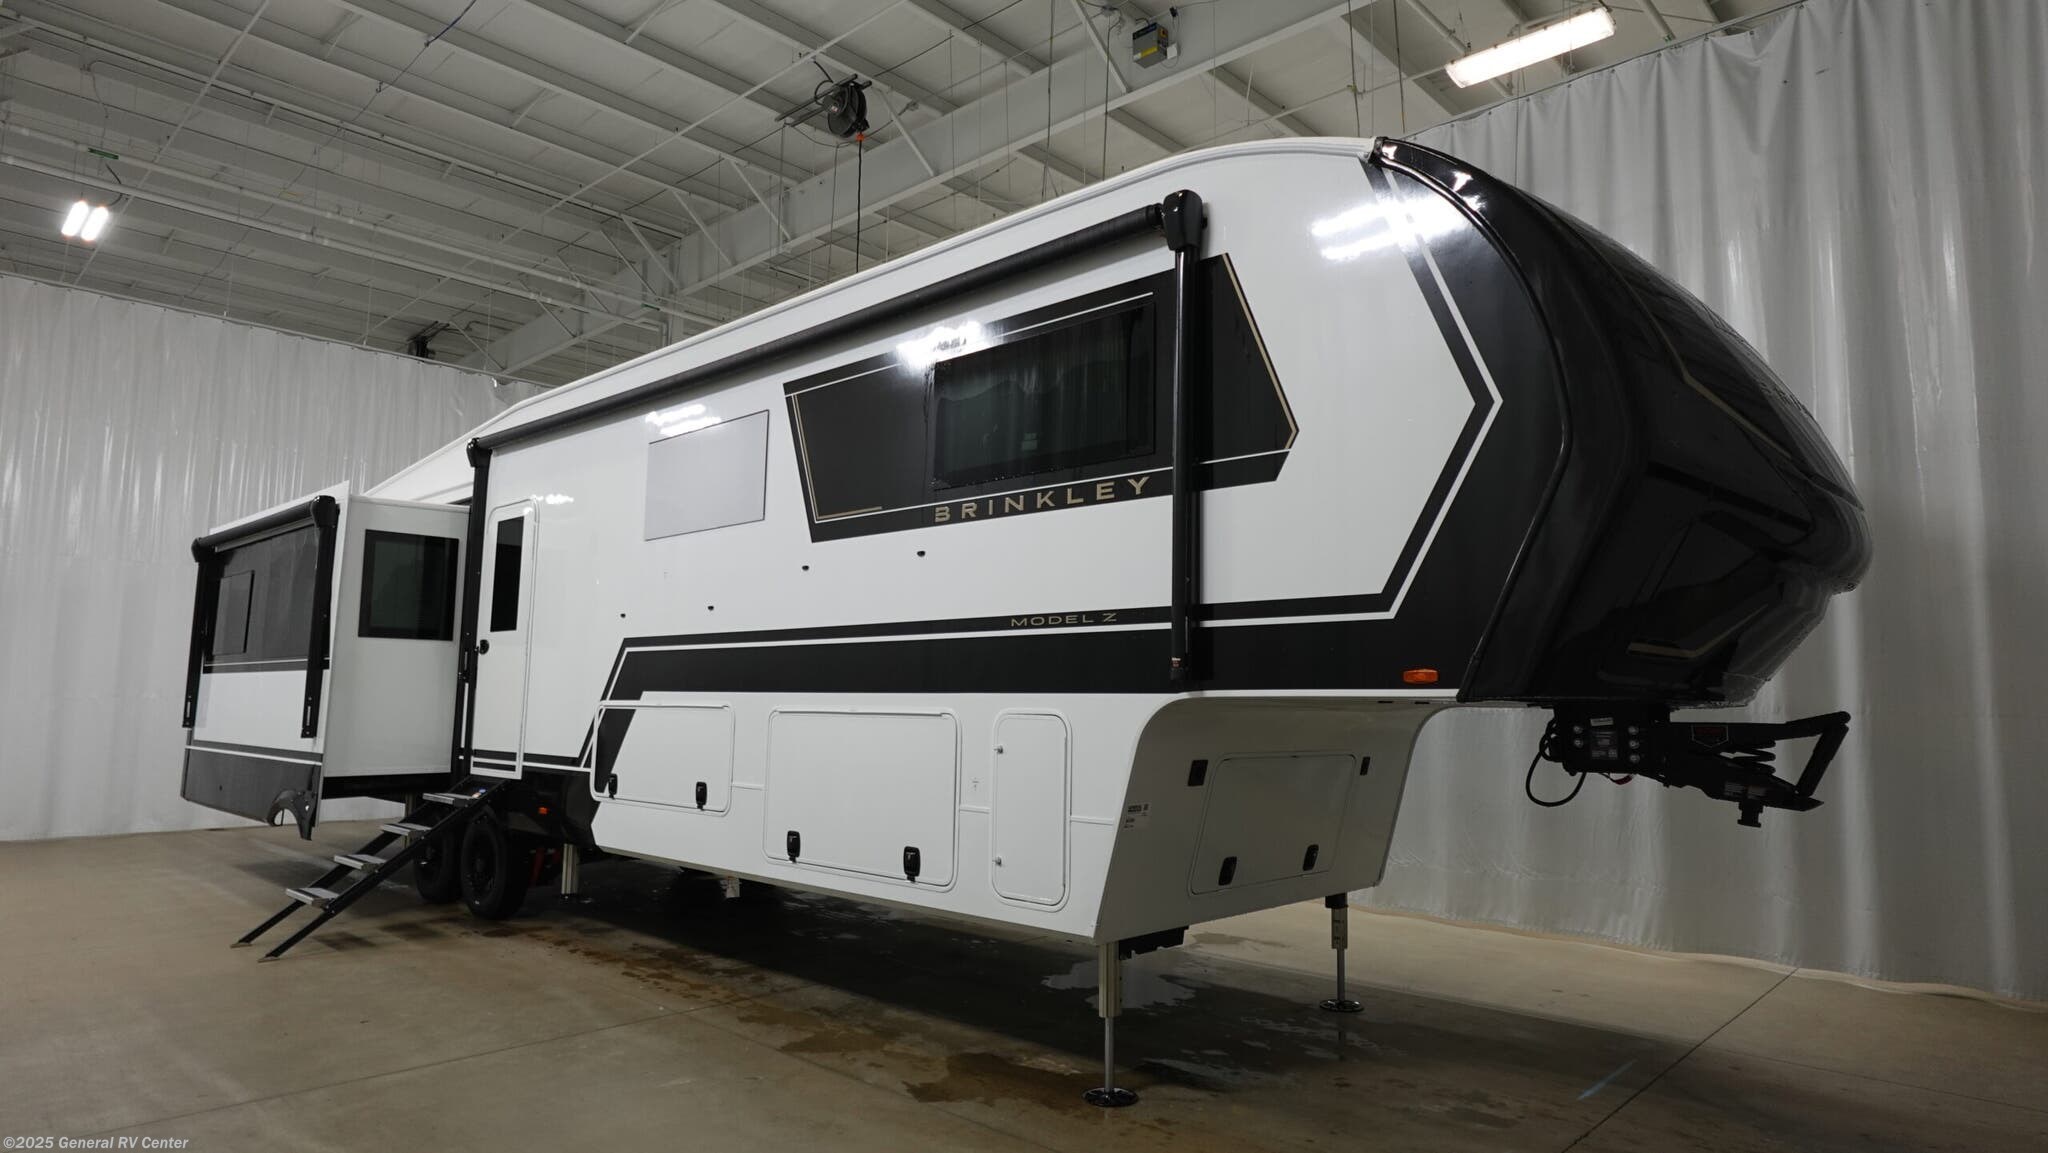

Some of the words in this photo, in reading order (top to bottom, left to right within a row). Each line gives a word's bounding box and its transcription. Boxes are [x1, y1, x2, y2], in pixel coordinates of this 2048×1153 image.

[934, 476, 1149, 523] BRINKLEY
[1011, 614, 1095, 627] MODEL
[1102, 612, 1118, 623] Z
